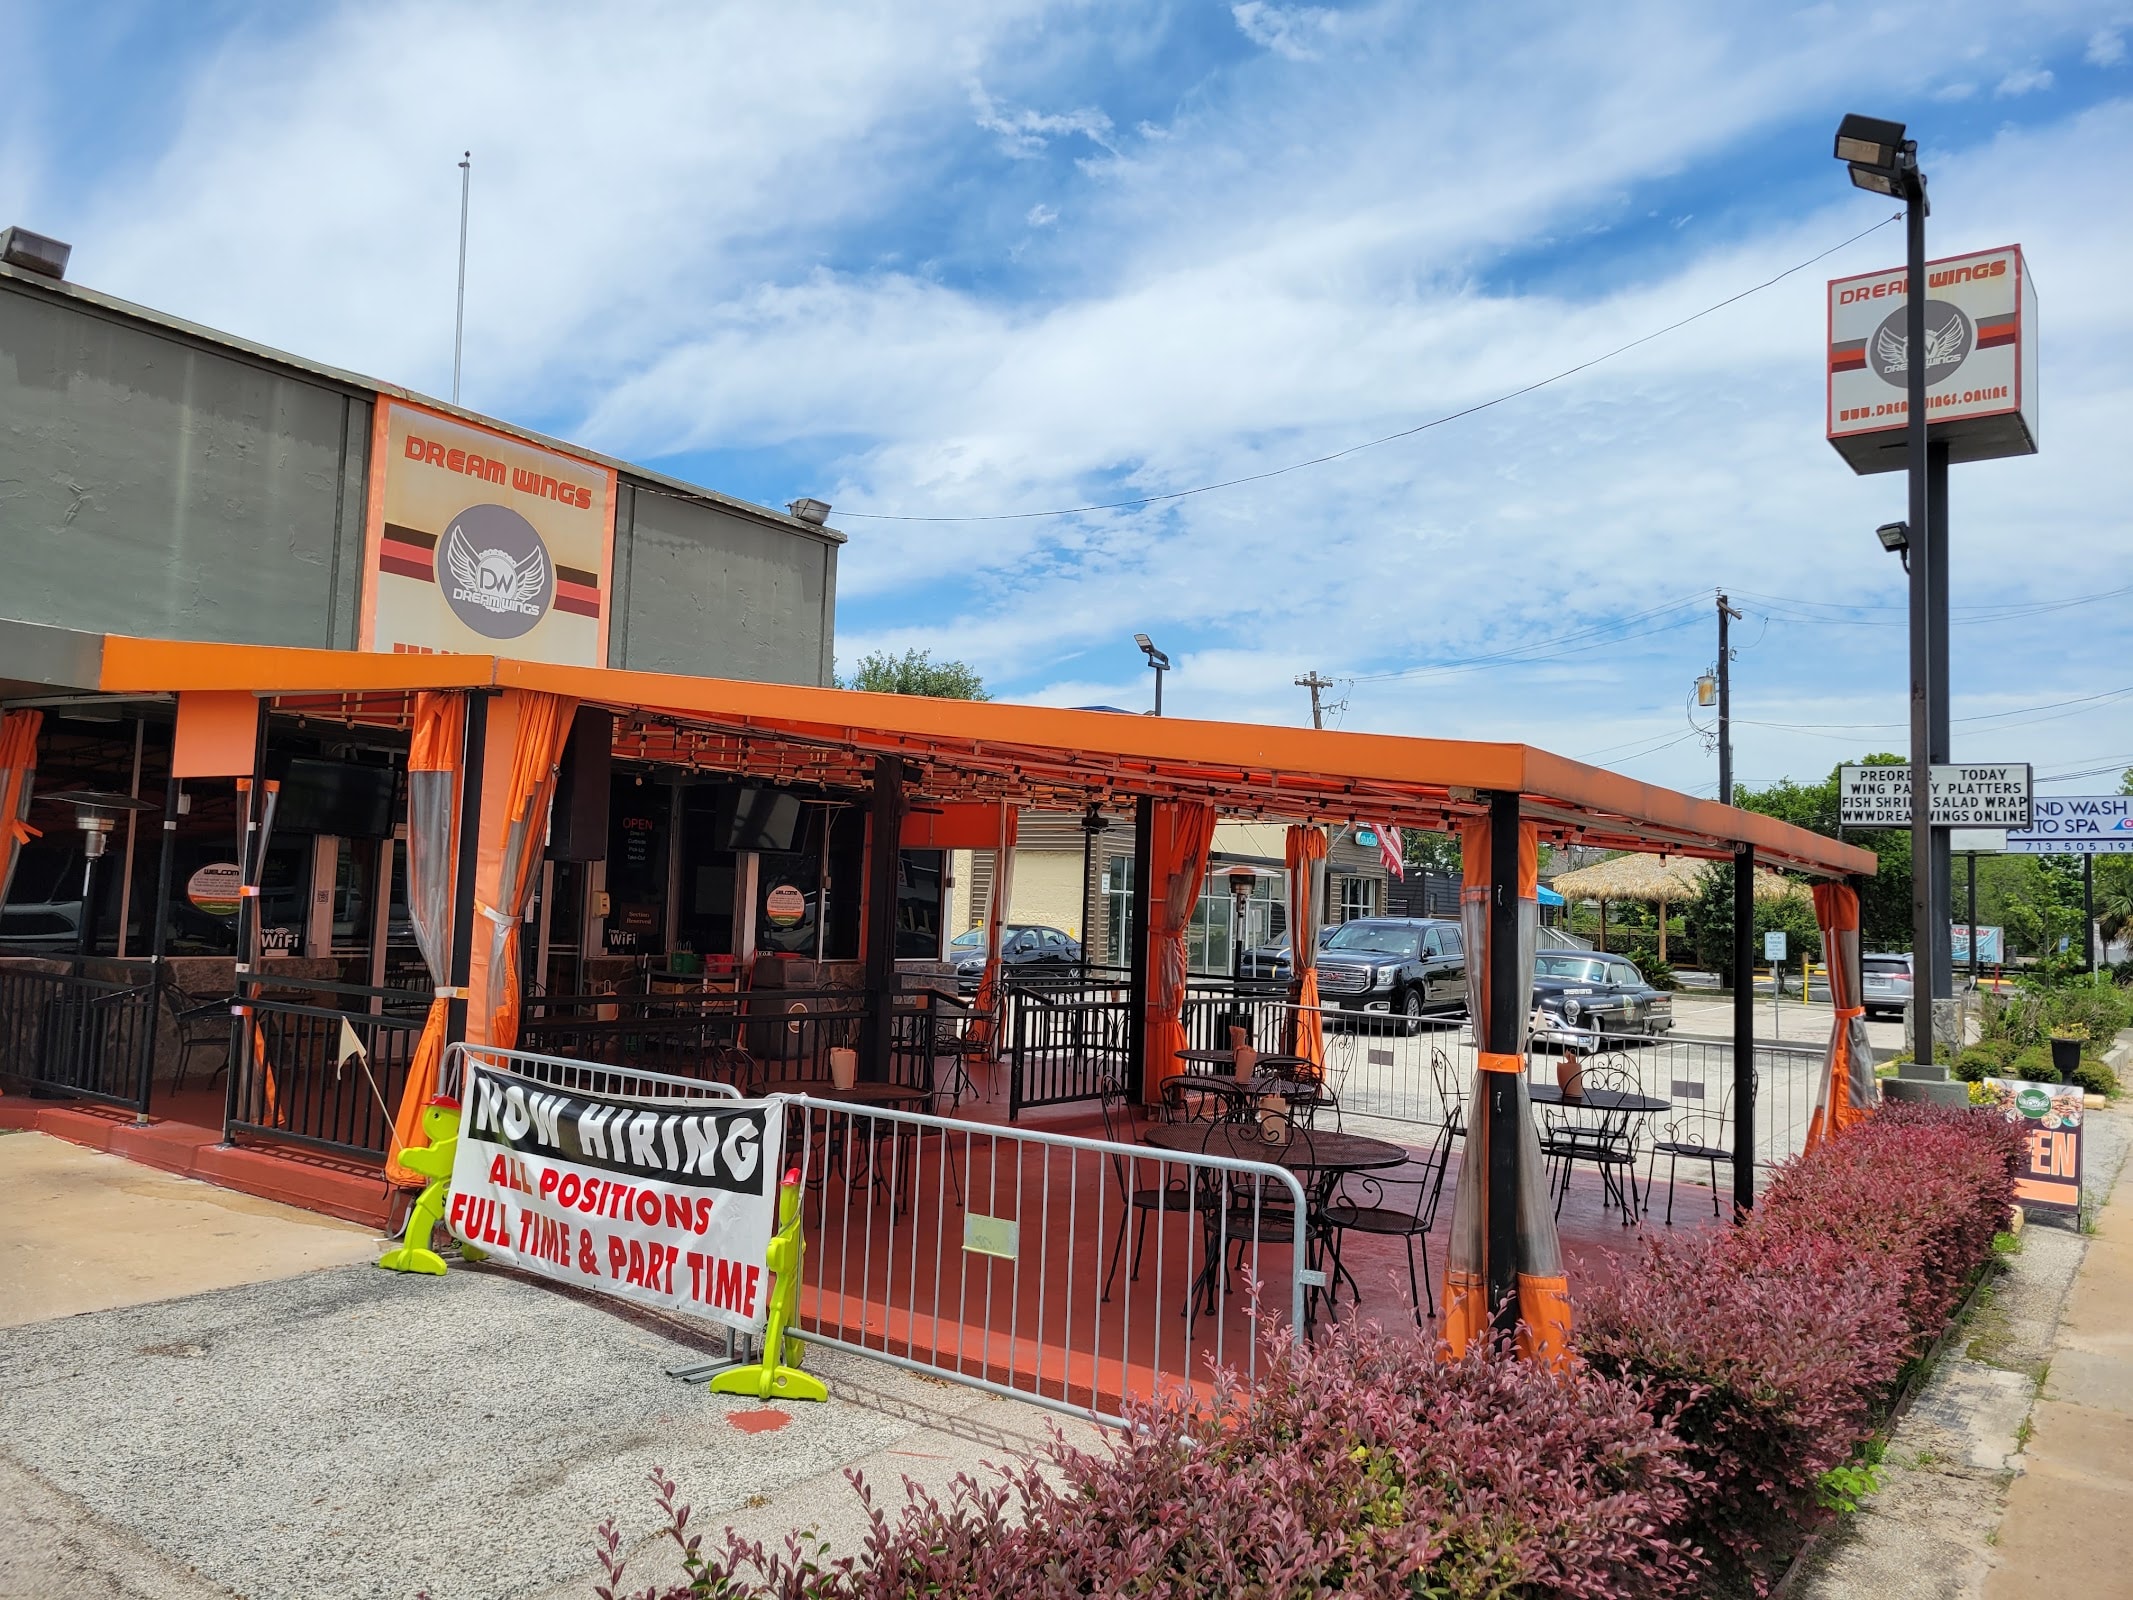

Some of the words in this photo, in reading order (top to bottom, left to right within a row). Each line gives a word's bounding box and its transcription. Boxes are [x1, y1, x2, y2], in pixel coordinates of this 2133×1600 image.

[1928, 259, 2007, 289] WINGS
[404, 435, 507, 486] DREAM
[512, 467, 592, 510] WINGS
[479, 567, 514, 595] DW
[1960, 768, 2008, 781] TODAY
[1851, 783, 1886, 795] WING
[1893, 783, 1940, 795] PAY
[1948, 782, 2022, 794] PLATTERS
[1842, 797, 1871, 808] FISH
[1933, 796, 1979, 808] SALAD
[1985, 796, 2028, 808] WRAP
[2068, 800, 2127, 816] WASH
[622, 817, 653, 830] OPEN
[1973, 810, 2027, 822] ONLINE
[2065, 819, 2100, 834] SPA
[2025, 842, 2133, 852] 713.505.19
[204, 868, 240, 876] WELCOM
[261, 933, 300, 949] WiFi
[610, 933, 637, 946] WiFi
[475, 1076, 572, 1149] NOW
[577, 1102, 760, 1182] HIRING
[488, 1153, 534, 1196] ALL
[538, 1167, 714, 1236] POSITIONS
[449, 1192, 511, 1248] FULL
[519, 1208, 572, 1268] TIME
[577, 1228, 601, 1277] &
[608, 1234, 680, 1296] PART
[687, 1251, 761, 1319] TIME
